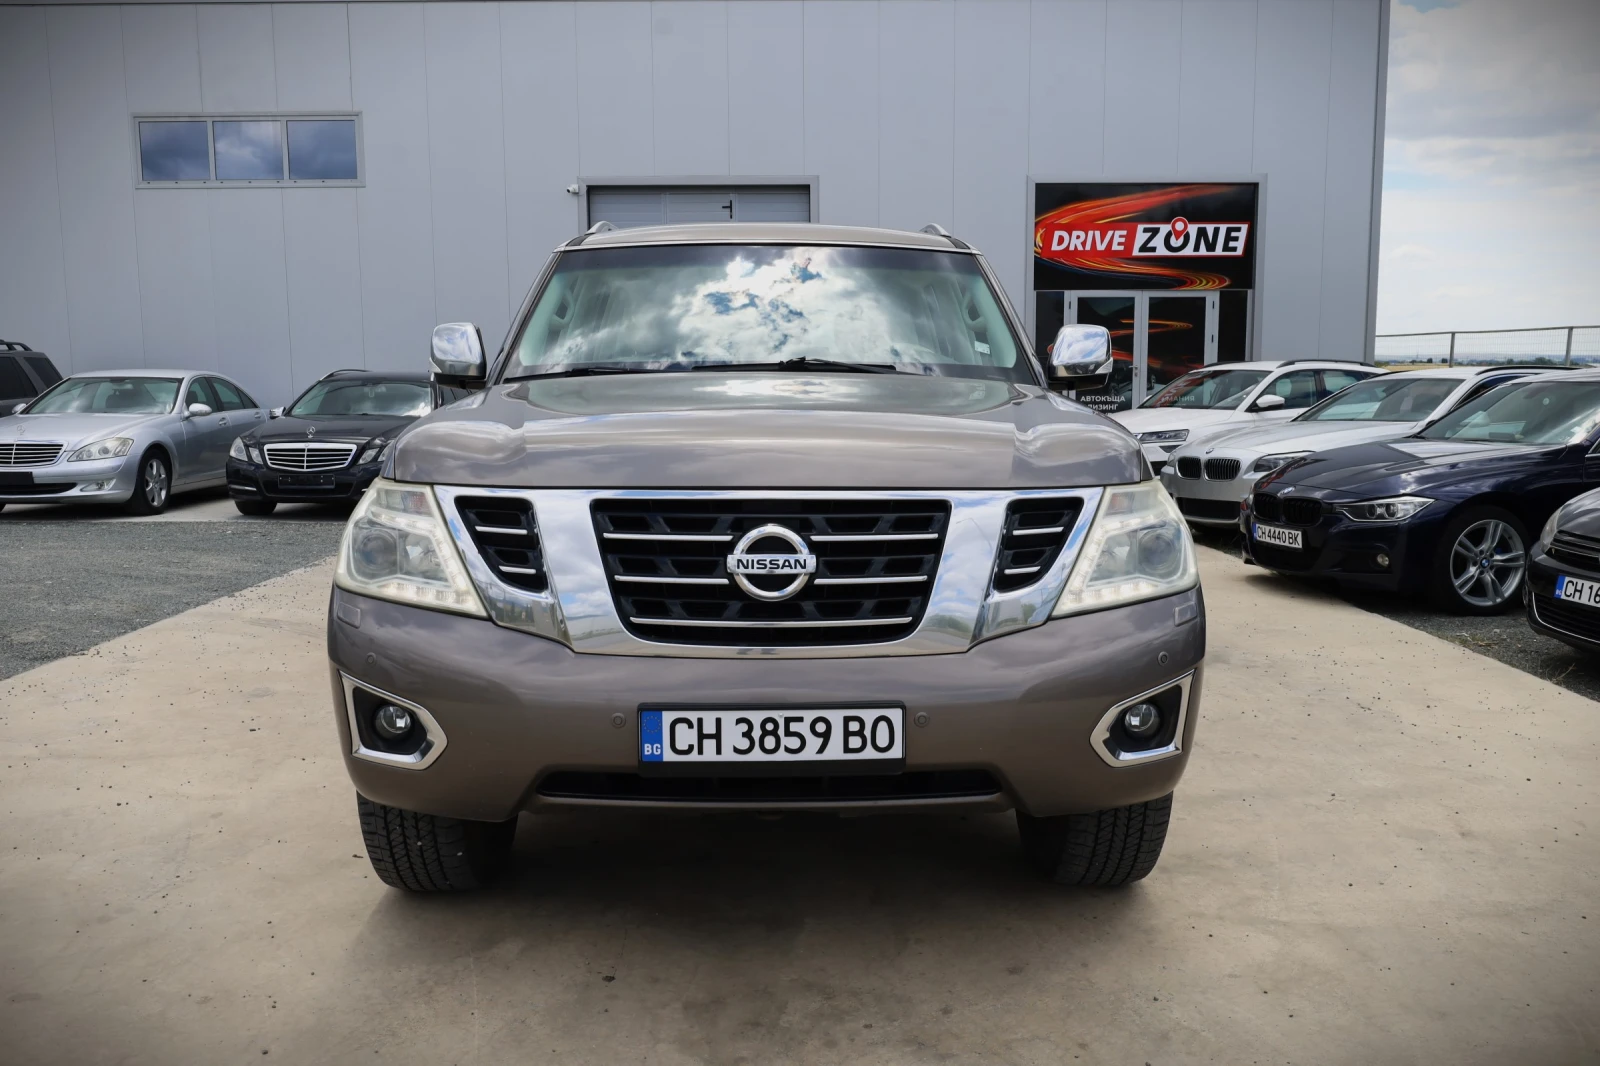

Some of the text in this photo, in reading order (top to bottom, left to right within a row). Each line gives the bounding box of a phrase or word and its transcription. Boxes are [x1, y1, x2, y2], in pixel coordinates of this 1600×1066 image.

[1051, 225, 1242, 253] DRIVE ZONE
[1080, 395, 1126, 403] АВТОКЪЩА
[1257, 526, 1267, 540] CH
[1267, 528, 1287, 544] 4440
[1288, 532, 1300, 546] BK
[736, 558, 807, 570] NISSAN
[1564, 580, 1584, 601] CH
[669, 715, 895, 756] CH 3859 BO
[644, 743, 661, 755] BG
